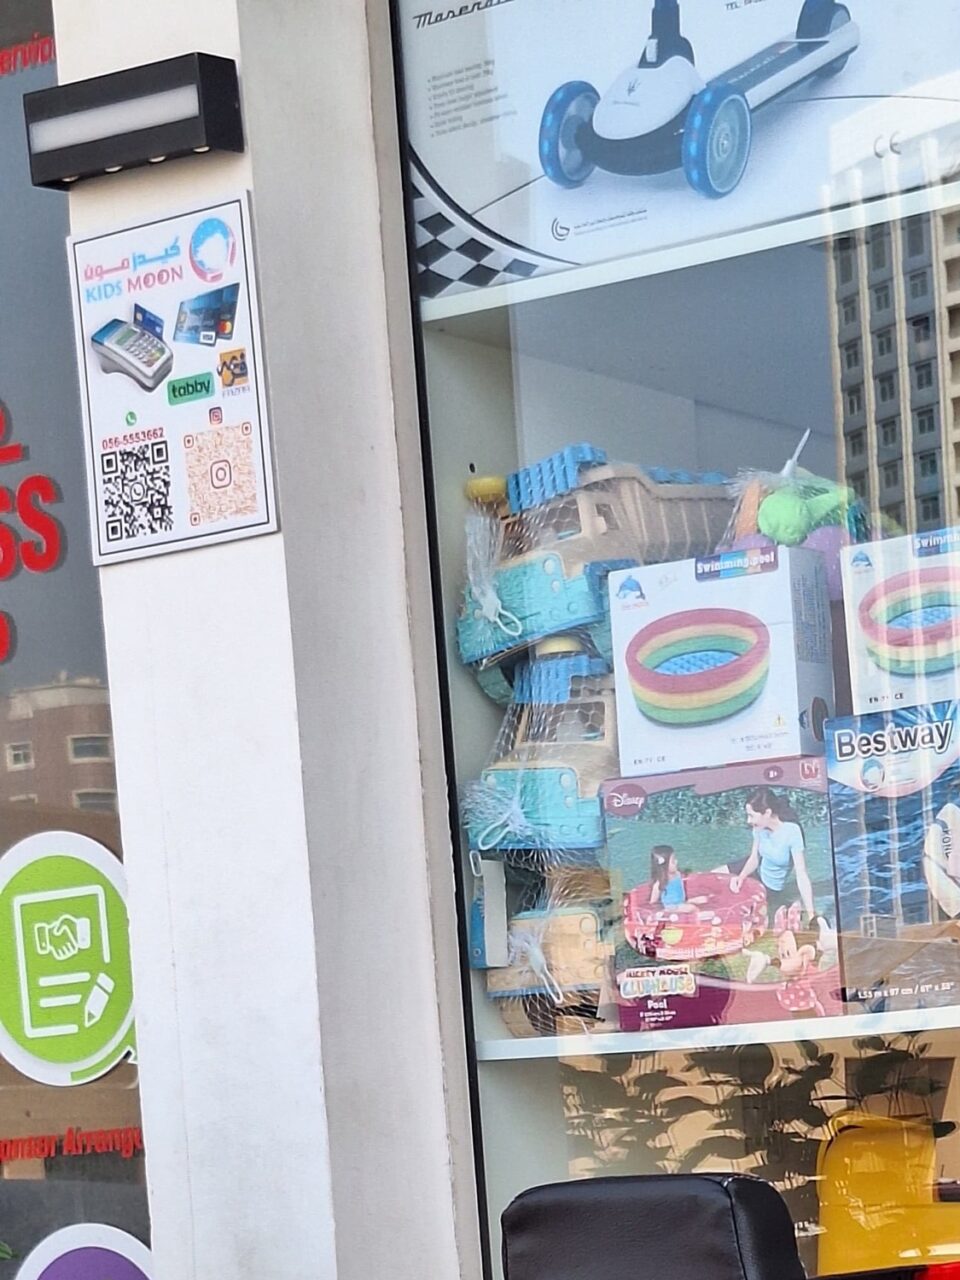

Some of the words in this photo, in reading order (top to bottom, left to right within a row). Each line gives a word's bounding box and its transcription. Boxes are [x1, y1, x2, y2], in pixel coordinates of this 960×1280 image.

[413, 0, 515, 29] Masera
[83, 256, 130, 281] مون
[131, 234, 181, 271] كيدز
[85, 280, 123, 304] KIDS
[127, 264, 184, 294] MOON
[171, 378, 211, 399] tabby
[834, 719, 954, 762] Bestway
